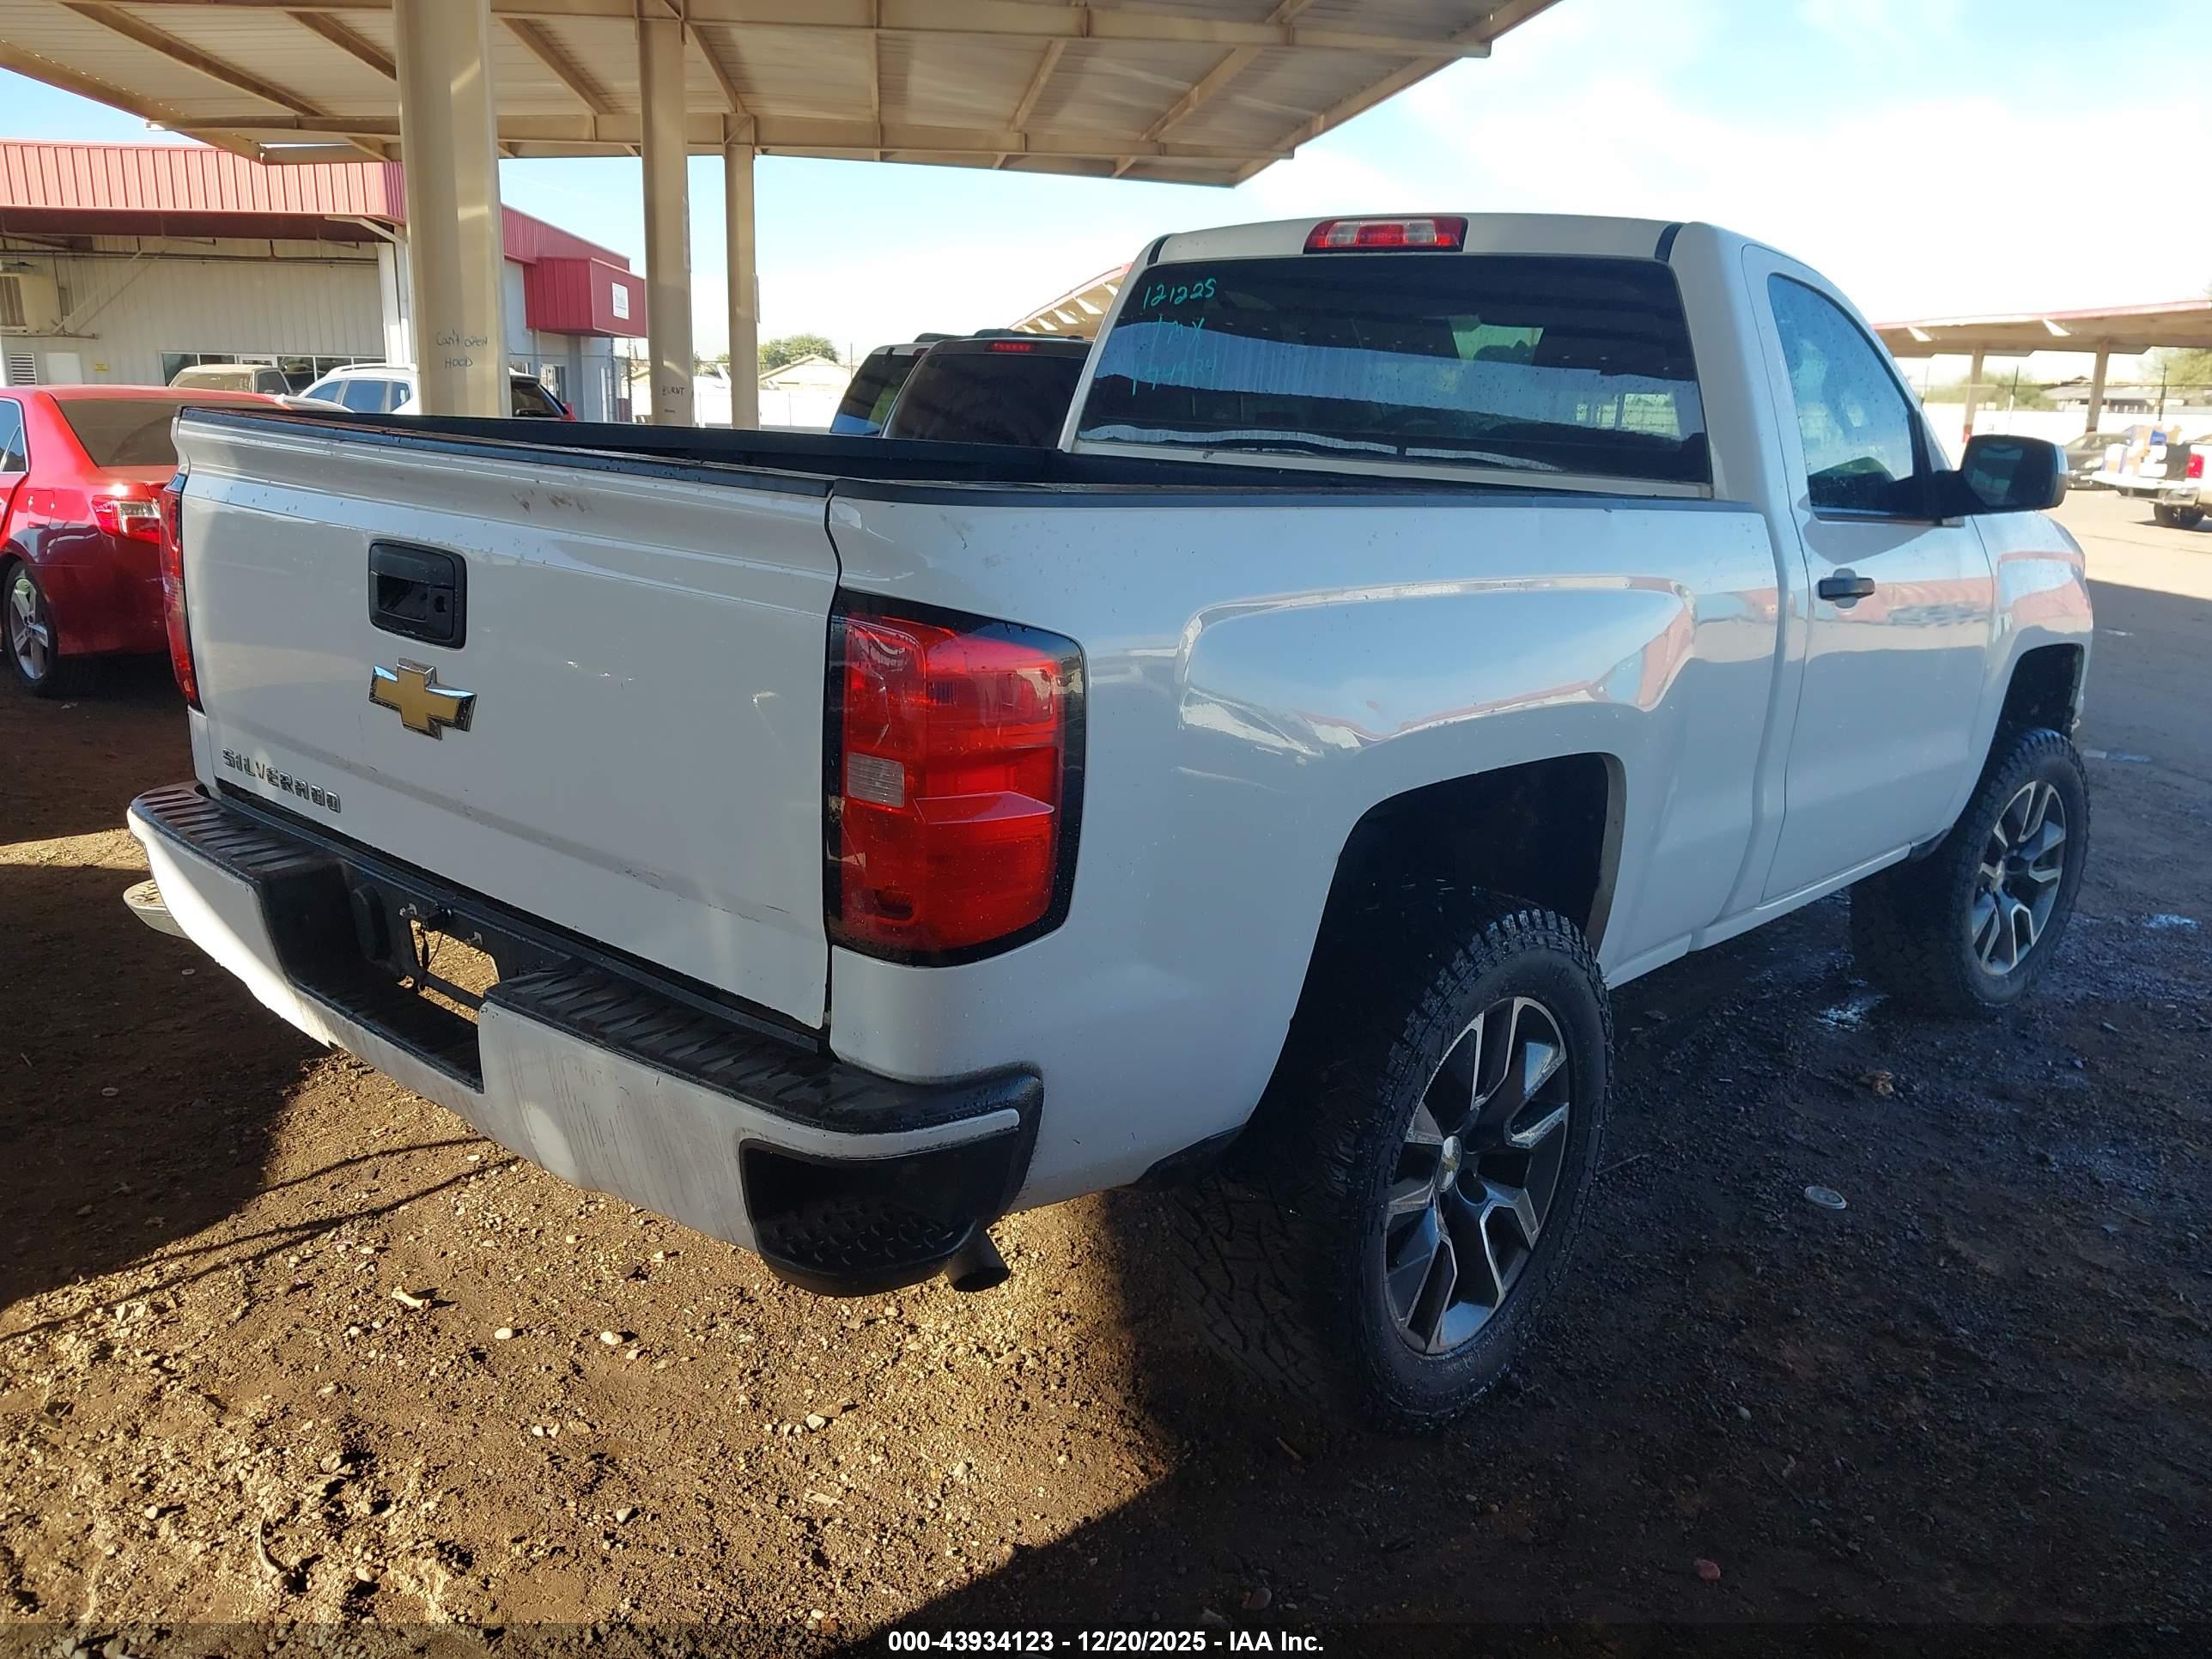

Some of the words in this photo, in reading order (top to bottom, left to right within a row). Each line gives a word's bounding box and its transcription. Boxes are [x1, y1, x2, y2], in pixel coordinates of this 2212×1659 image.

[1143, 277, 1217, 310] 121225
[444, 356, 474, 369] HOOD
[222, 747, 343, 814] SILVERADO
